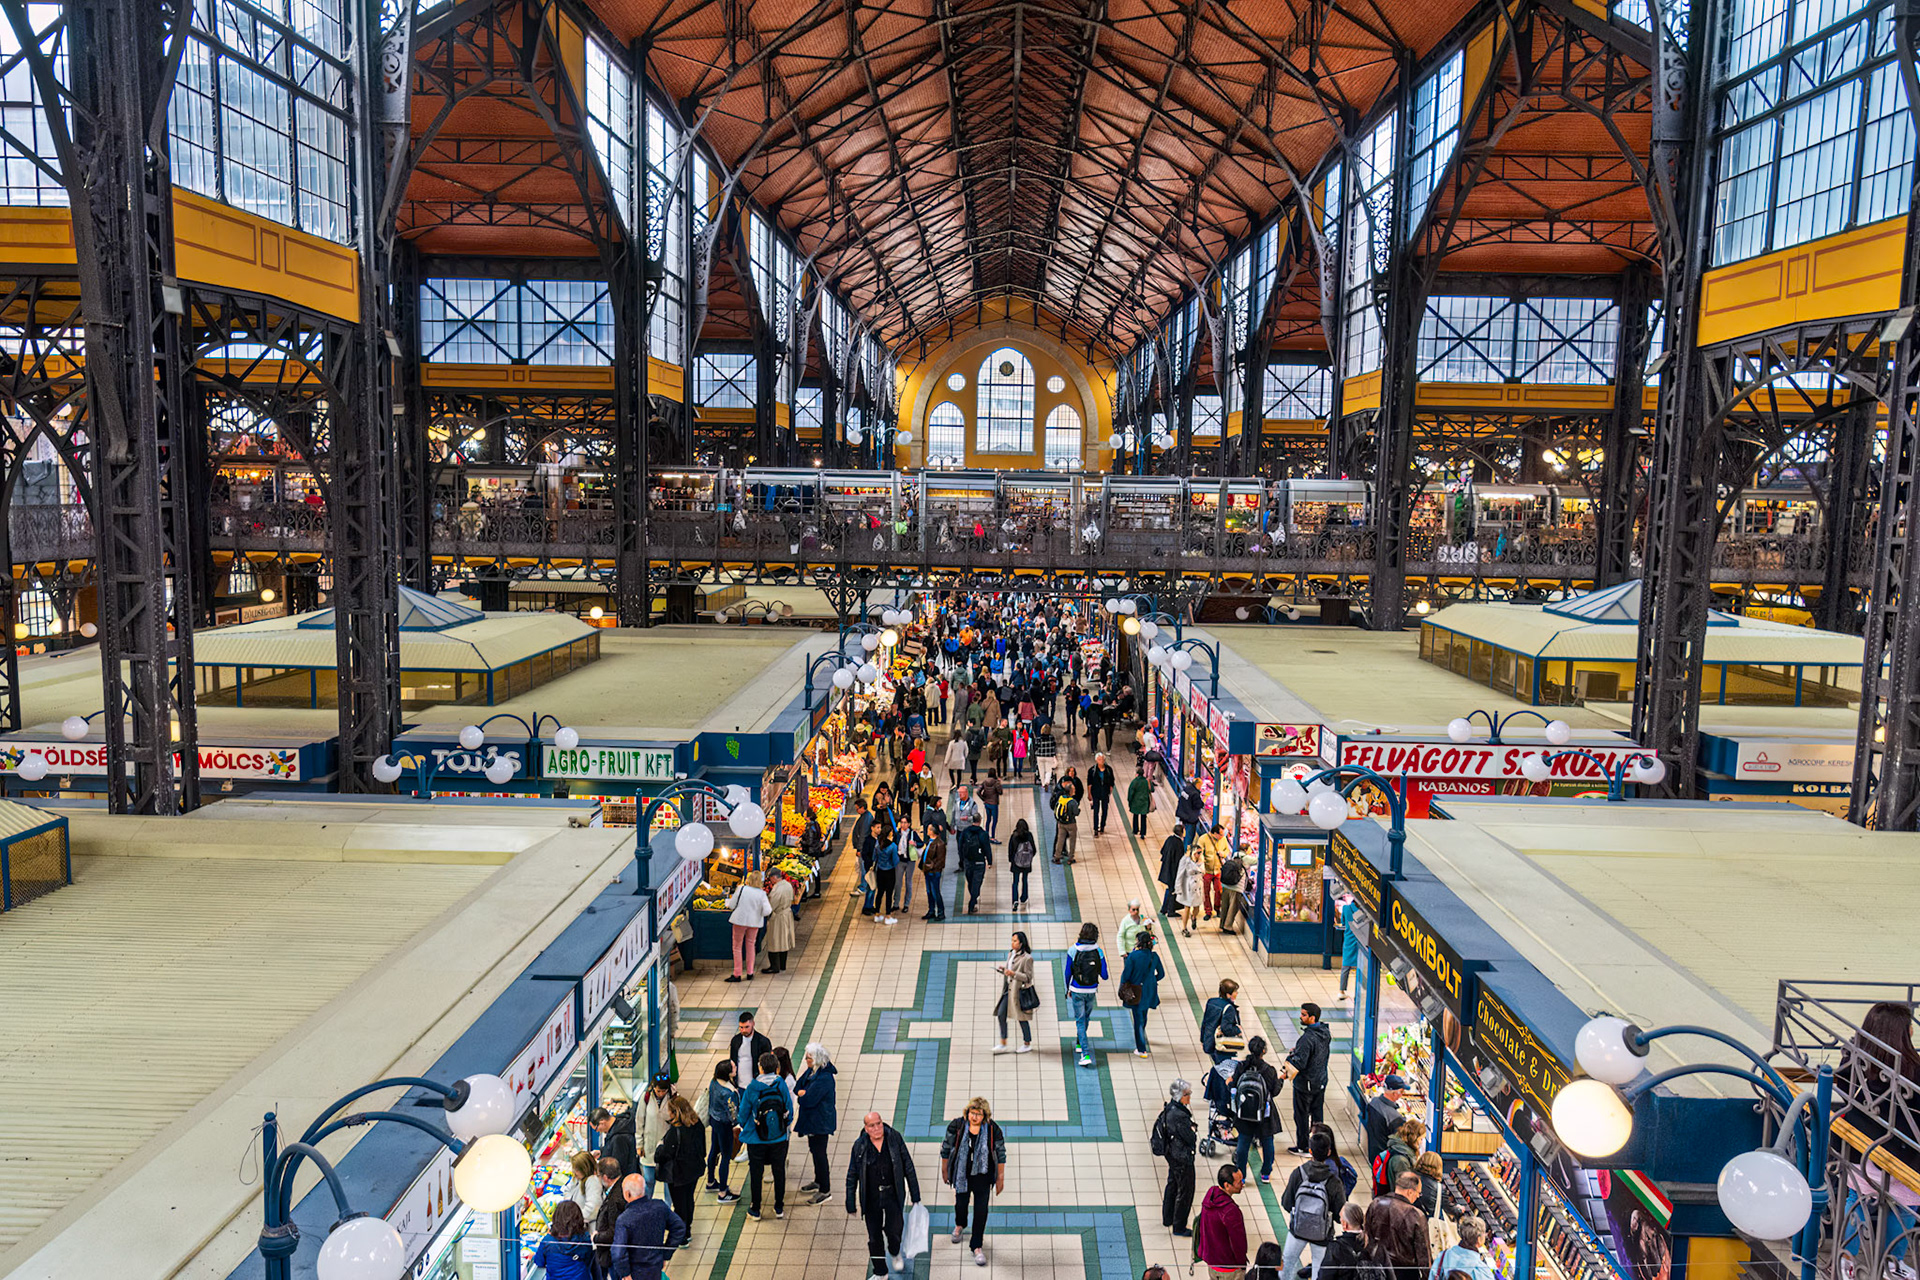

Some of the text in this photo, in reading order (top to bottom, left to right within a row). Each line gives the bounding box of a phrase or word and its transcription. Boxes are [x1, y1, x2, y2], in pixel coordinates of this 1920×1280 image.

[547, 750, 674, 778] AGRO-FRUIT KFT.
[1343, 744, 1493, 776] FELVÁGOTT
[1418, 780, 1490, 794] KABANOS
[1477, 999, 1526, 1066] Chocolate
[1530, 1056, 1538, 1078] &
